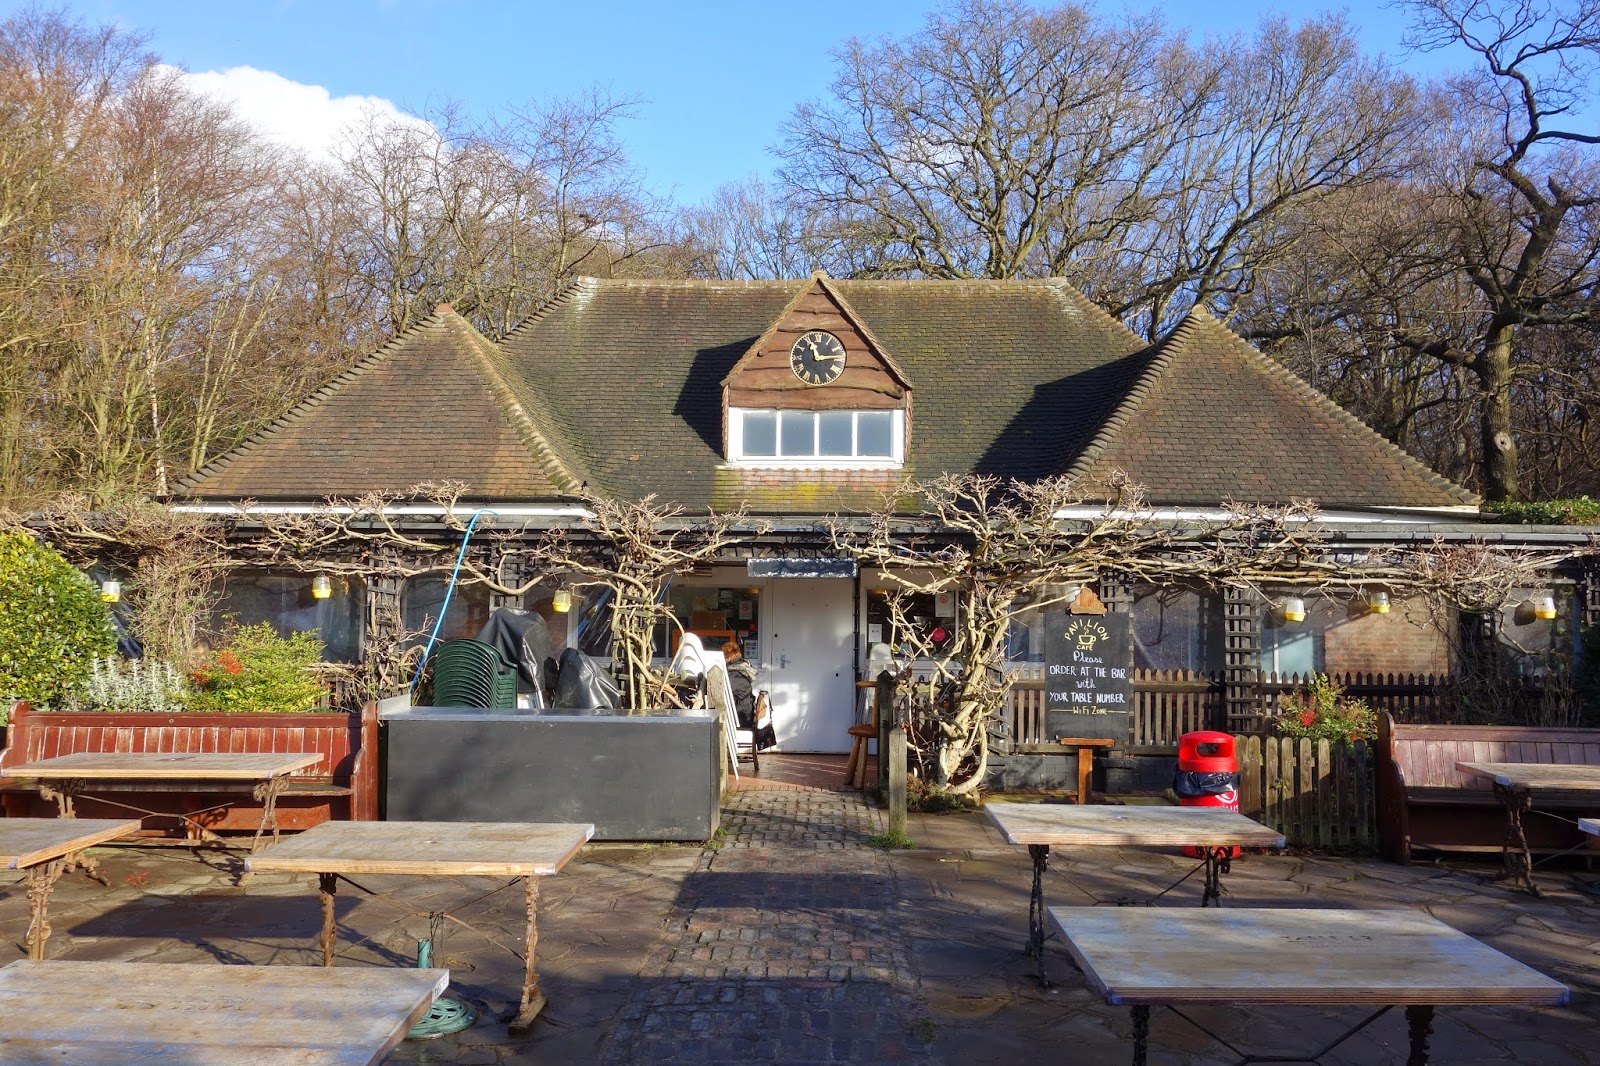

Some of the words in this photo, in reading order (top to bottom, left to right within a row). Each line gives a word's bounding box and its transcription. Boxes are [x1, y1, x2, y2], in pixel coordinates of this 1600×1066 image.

[1064, 619, 1110, 641] PAVILION
[1073, 650, 1103, 664] Please
[1050, 665, 1077, 677] ORDER
[1080, 666, 1091, 677] AT
[1094, 667, 1107, 678] THE
[1111, 668, 1126, 679] BAR
[1076, 678, 1096, 689] with
[1050, 692, 1069, 703] YOUR
[1071, 692, 1092, 704] TABLE
[1096, 693, 1125, 704] NUMBER
